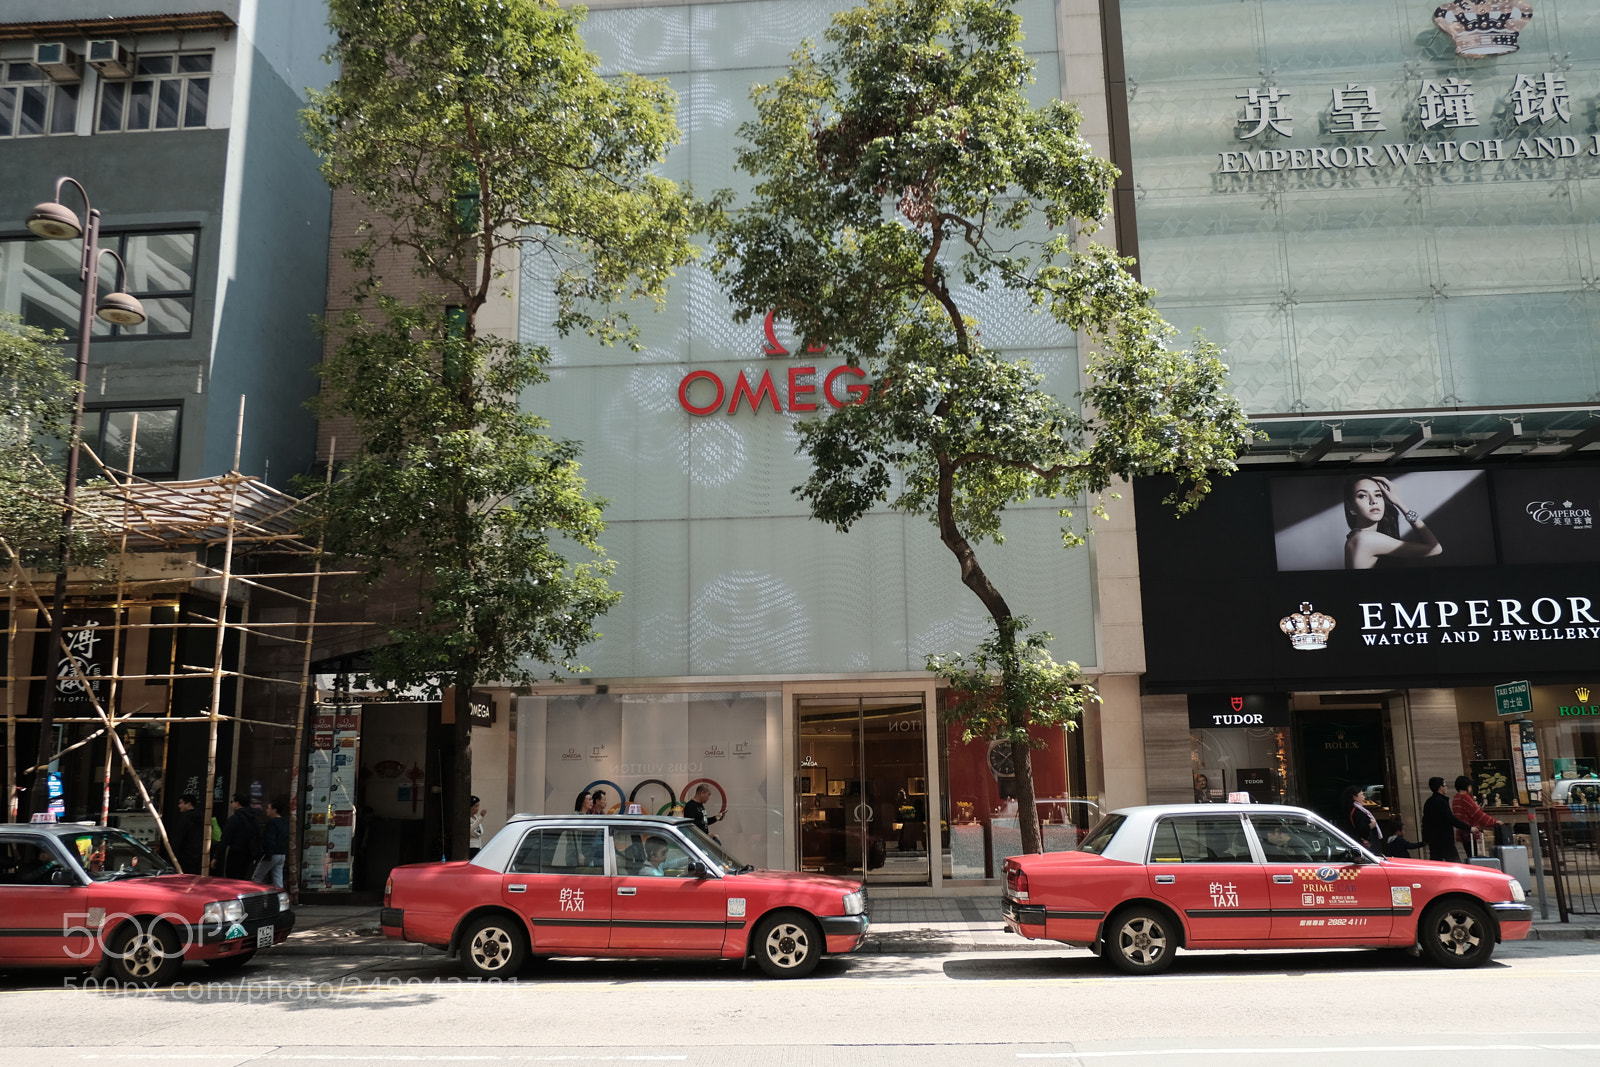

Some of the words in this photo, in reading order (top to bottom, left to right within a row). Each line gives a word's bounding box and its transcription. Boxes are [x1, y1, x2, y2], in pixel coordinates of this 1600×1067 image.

[1235, 72, 1574, 140] 英皇鐘錶
[1219, 145, 1378, 174] EMPEROR
[1382, 138, 1506, 166] WATCH
[1511, 135, 1581, 160] AND
[678, 364, 890, 416] OMEG
[1525, 500, 1592, 525] EMPEROR
[1358, 597, 1600, 630] EMPEROR
[1362, 632, 1429, 646] WATCH
[1440, 630, 1481, 644] AND
[1492, 627, 1600, 643] JEWELLERY
[1496, 688, 1508, 697] TAXI
[1508, 684, 1527, 695] STAND
[1502, 697, 1524, 709] 的士站
[1559, 705, 1600, 716] ROLE
[1212, 713, 1264, 725] TUDOR
[1324, 741, 1359, 750] ROLEX
[559, 887, 585, 900] 的士
[1209, 881, 1238, 895] 的士
[1302, 883, 1335, 893] PRIME
[1336, 884, 1357, 893] CAB
[558, 899, 585, 912] TAXI
[1210, 894, 1239, 908] TAXI
[1327, 918, 1347, 926] 2882
[1347, 918, 1368, 926] 4111
